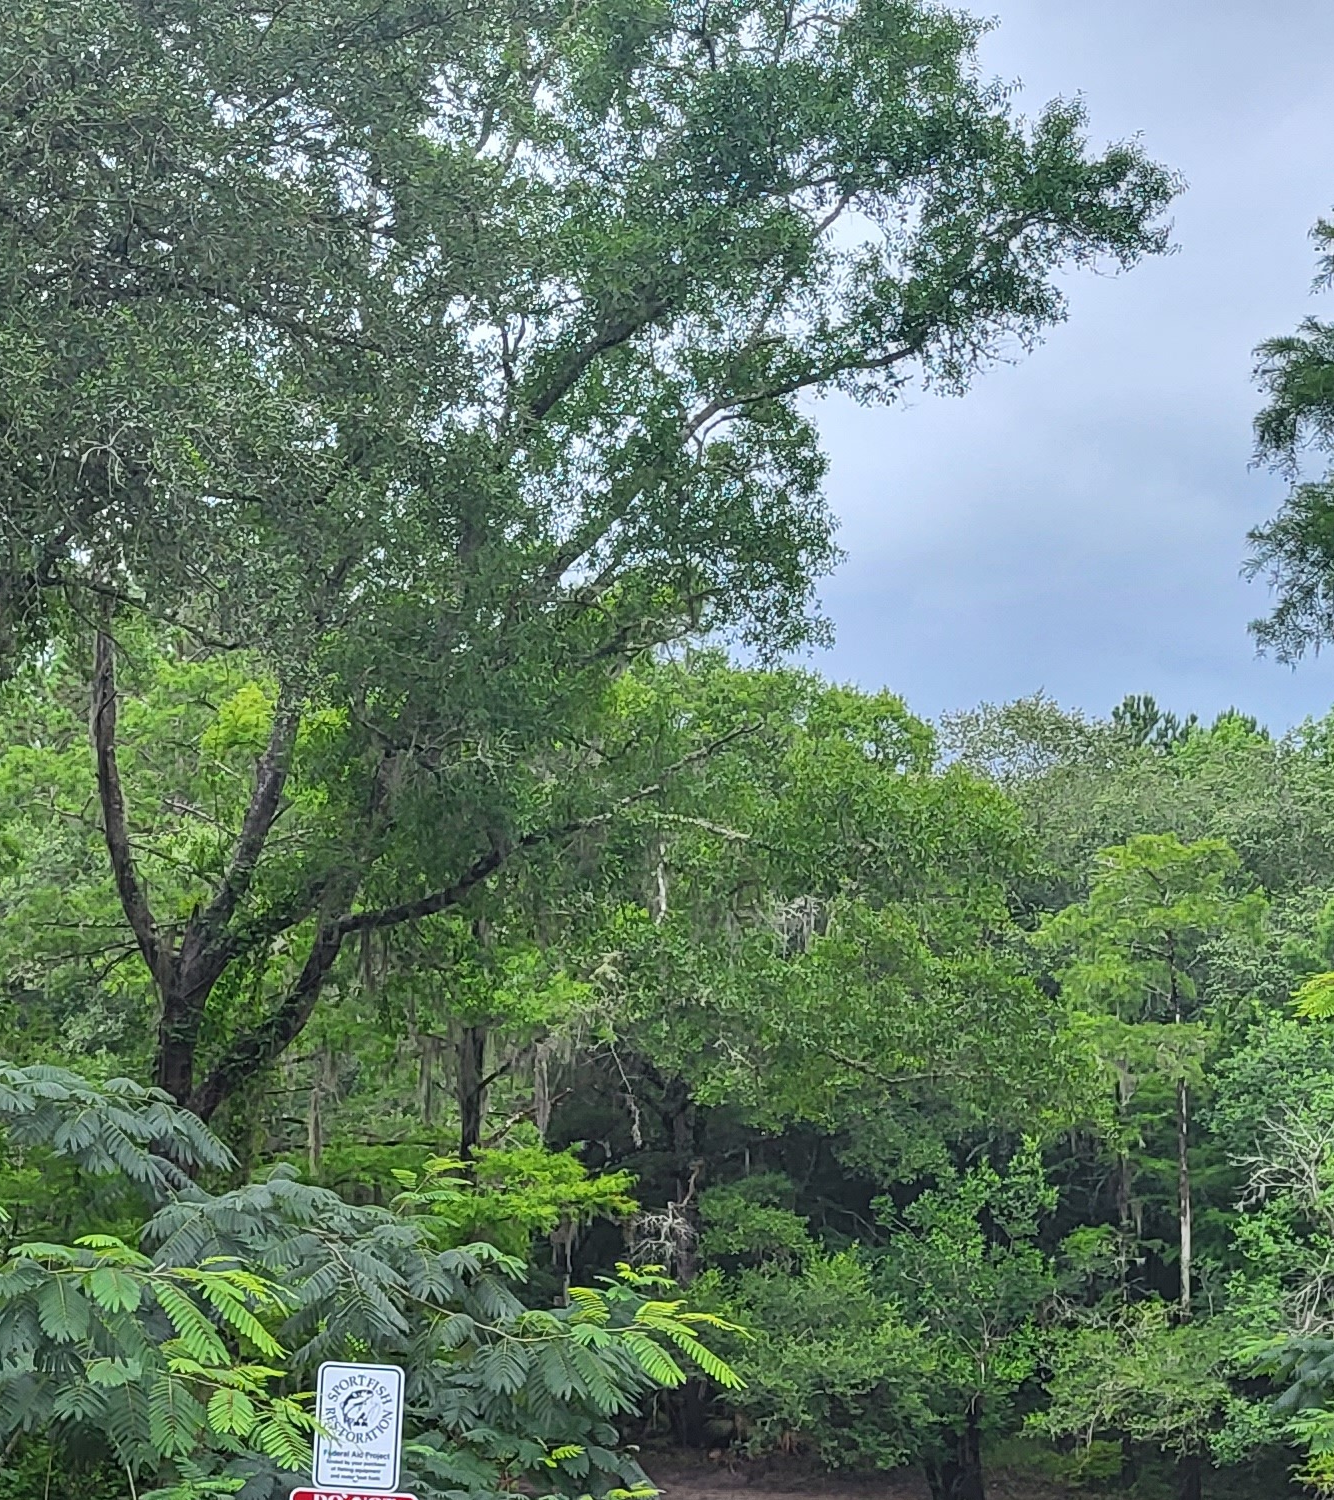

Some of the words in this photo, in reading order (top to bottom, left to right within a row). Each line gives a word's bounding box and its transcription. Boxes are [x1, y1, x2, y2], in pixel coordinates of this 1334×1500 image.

[328, 1374, 367, 1402] SPORT
[367, 1377, 393, 1405] FISH
[325, 1407, 394, 1444] RESTORATION
[365, 1451, 390, 1460] Project
